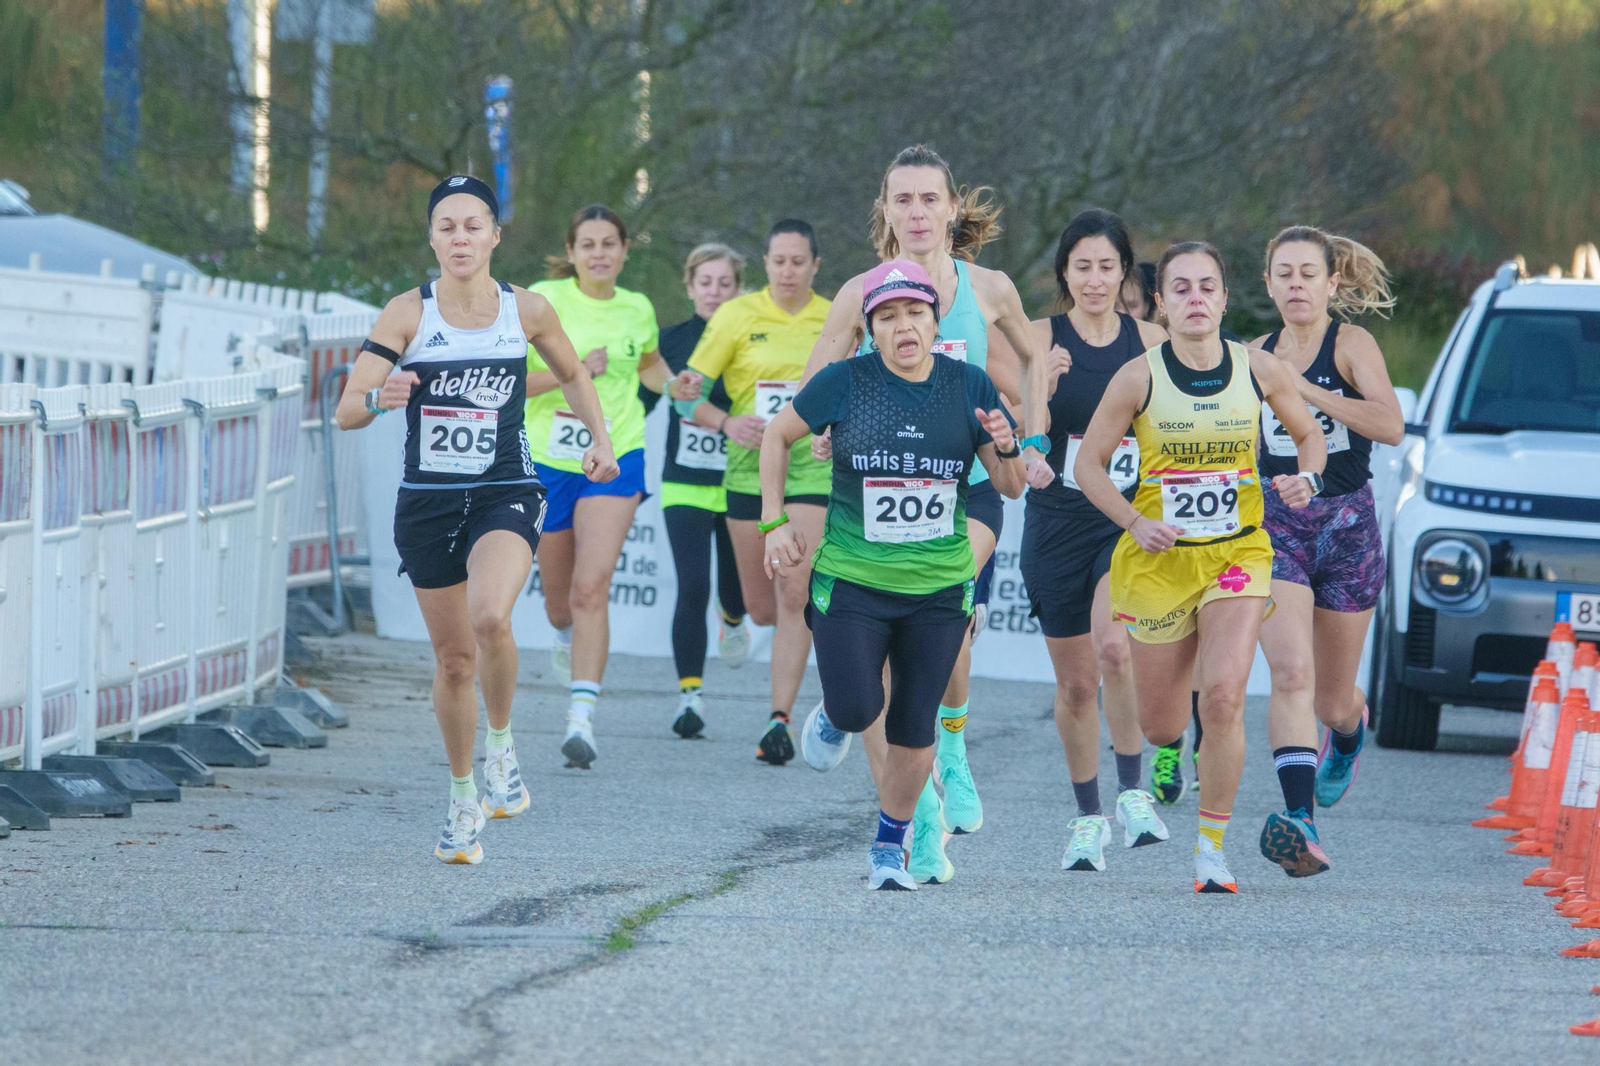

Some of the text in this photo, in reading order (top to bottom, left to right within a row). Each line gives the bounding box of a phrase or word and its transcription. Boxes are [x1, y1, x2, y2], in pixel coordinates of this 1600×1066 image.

[883, 275, 908, 284] adidas
[425, 340, 449, 348] adidas
[429, 367, 517, 397] delikia
[475, 392, 499, 402] fresh
[1272, 411, 1335, 436] 23
[430, 424, 496, 454] 205
[896, 430, 924, 439] amura
[1160, 439, 1252, 455] ATHLETICS
[852, 449, 964, 480] máis que auga
[1174, 454, 1236, 465] San Lázaro
[876, 493, 945, 523] 206
[1174, 487, 1238, 518] 209
[632, 556, 657, 576] de
